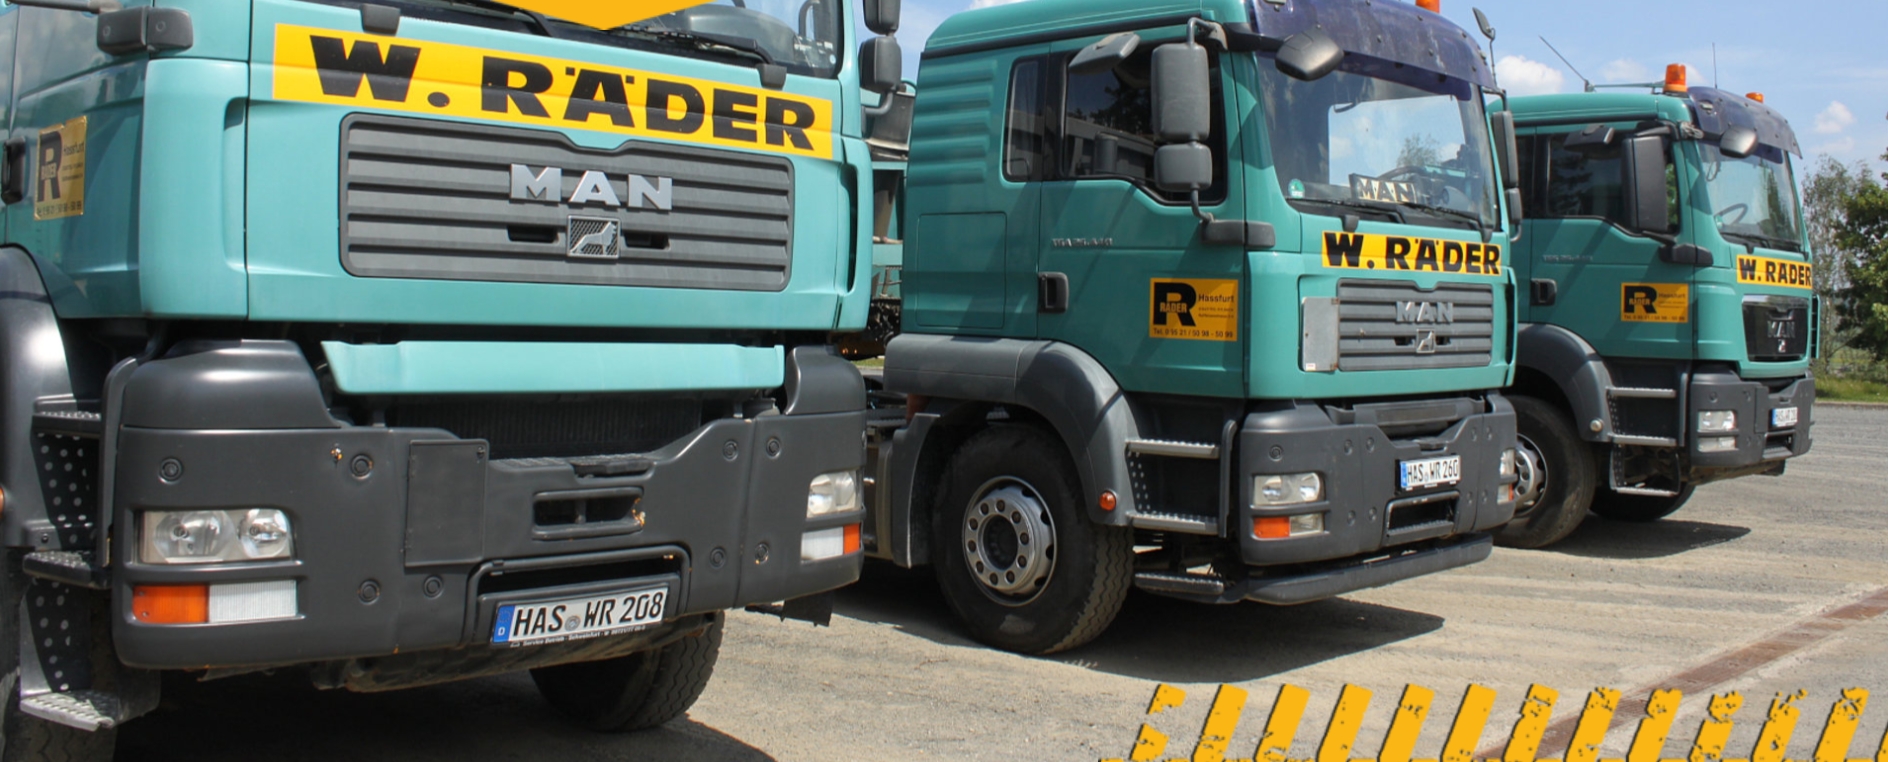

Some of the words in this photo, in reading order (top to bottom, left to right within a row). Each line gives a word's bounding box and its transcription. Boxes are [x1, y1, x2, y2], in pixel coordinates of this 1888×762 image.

[309, 34, 451, 108] W.
[481, 55, 816, 151] RÄDER
[37, 131, 62, 202] R
[510, 163, 673, 210] MAN
[1357, 178, 1417, 203] MAN
[1324, 232, 1374, 269] W.
[1385, 236, 1500, 275] RÄDER
[1739, 258, 1761, 281] W.
[1153, 282, 1197, 327] R
[1396, 301, 1454, 323] MAN
[1624, 286, 1657, 314] R
[1767, 320, 1796, 338] MAN
[1408, 464, 1424, 483] HAS
[1430, 462, 1441, 480] WR
[513, 605, 566, 637] HAS
[584, 598, 616, 628] WR
[619, 591, 664, 623] 208
[498, 627, 505, 636] D
